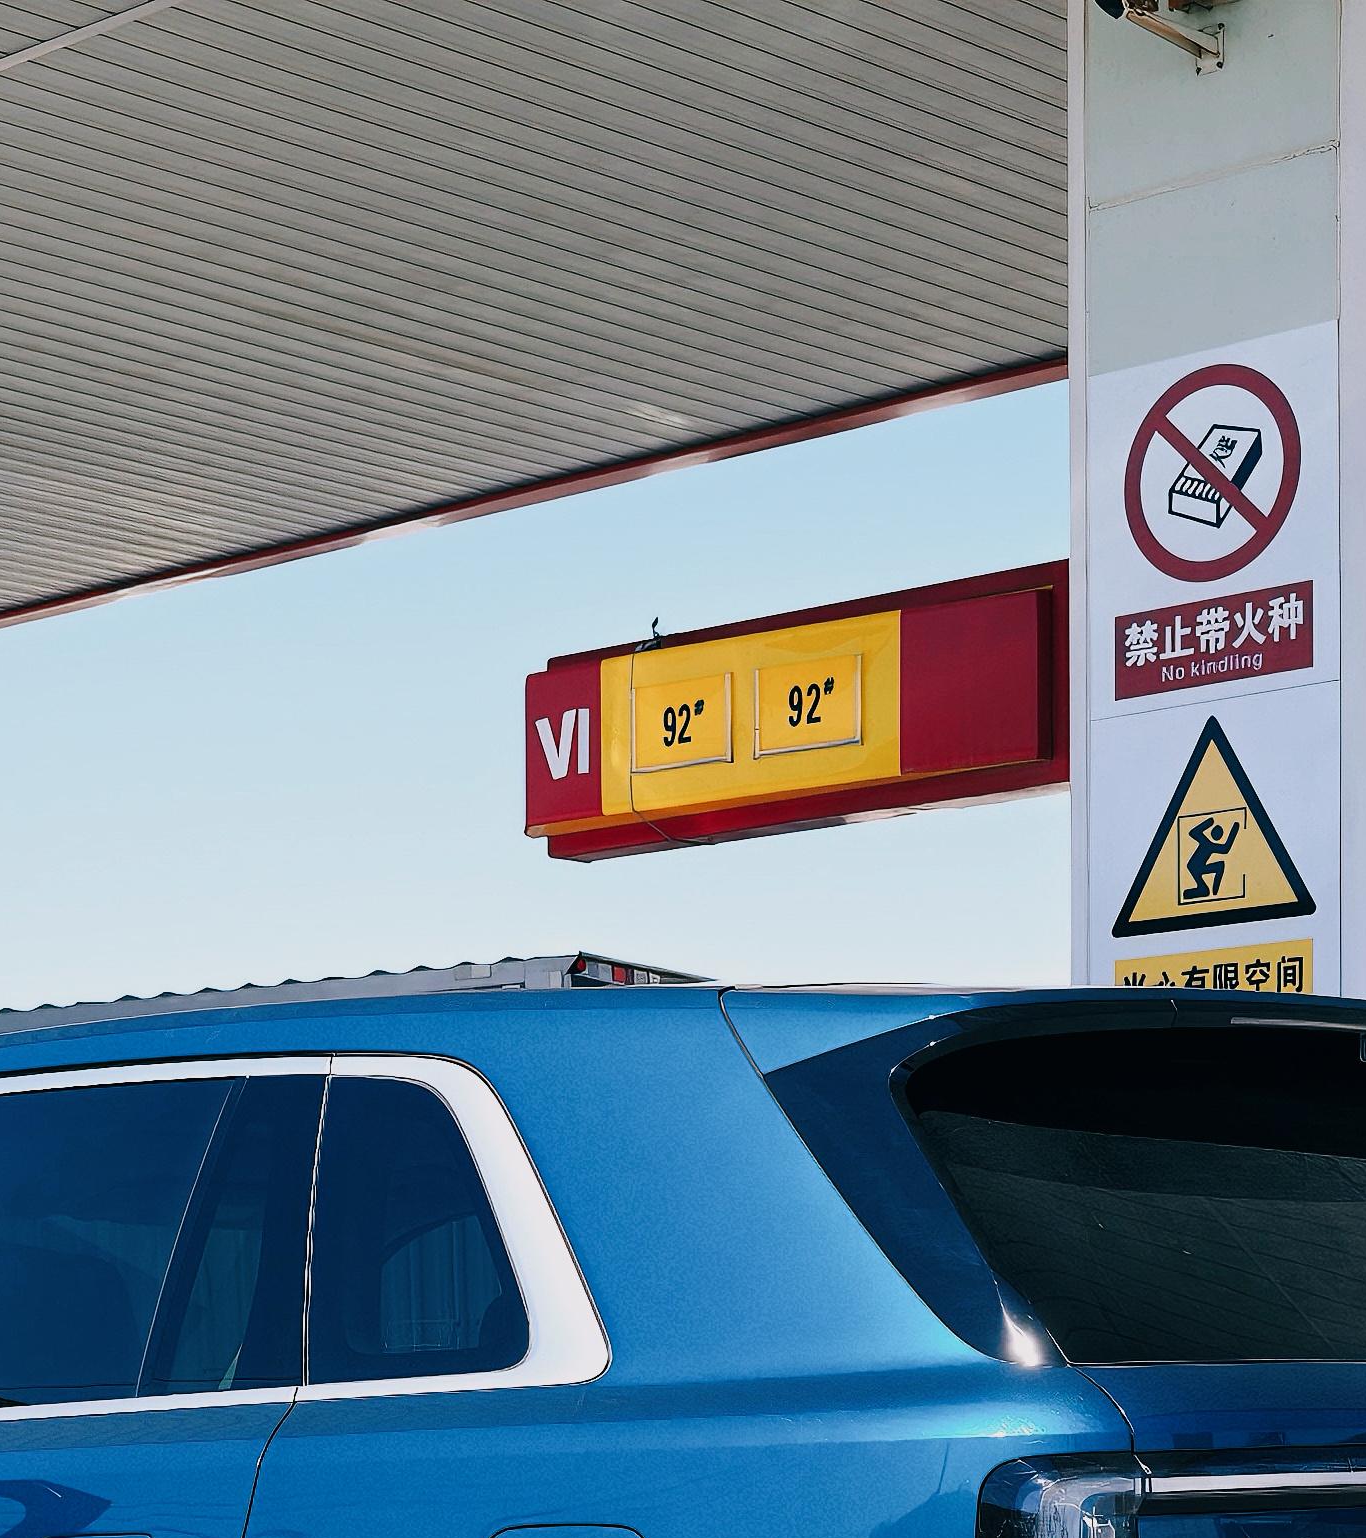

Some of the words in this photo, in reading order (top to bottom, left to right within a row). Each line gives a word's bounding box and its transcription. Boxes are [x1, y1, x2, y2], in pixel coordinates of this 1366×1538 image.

[1124, 593, 1304, 668] 禁止带火种
[1161, 664, 1185, 682] No
[1190, 653, 1263, 678] kindling
[535, 707, 591, 780] VI
[662, 699, 704, 747] 92#
[788, 676, 835, 728] 92#
